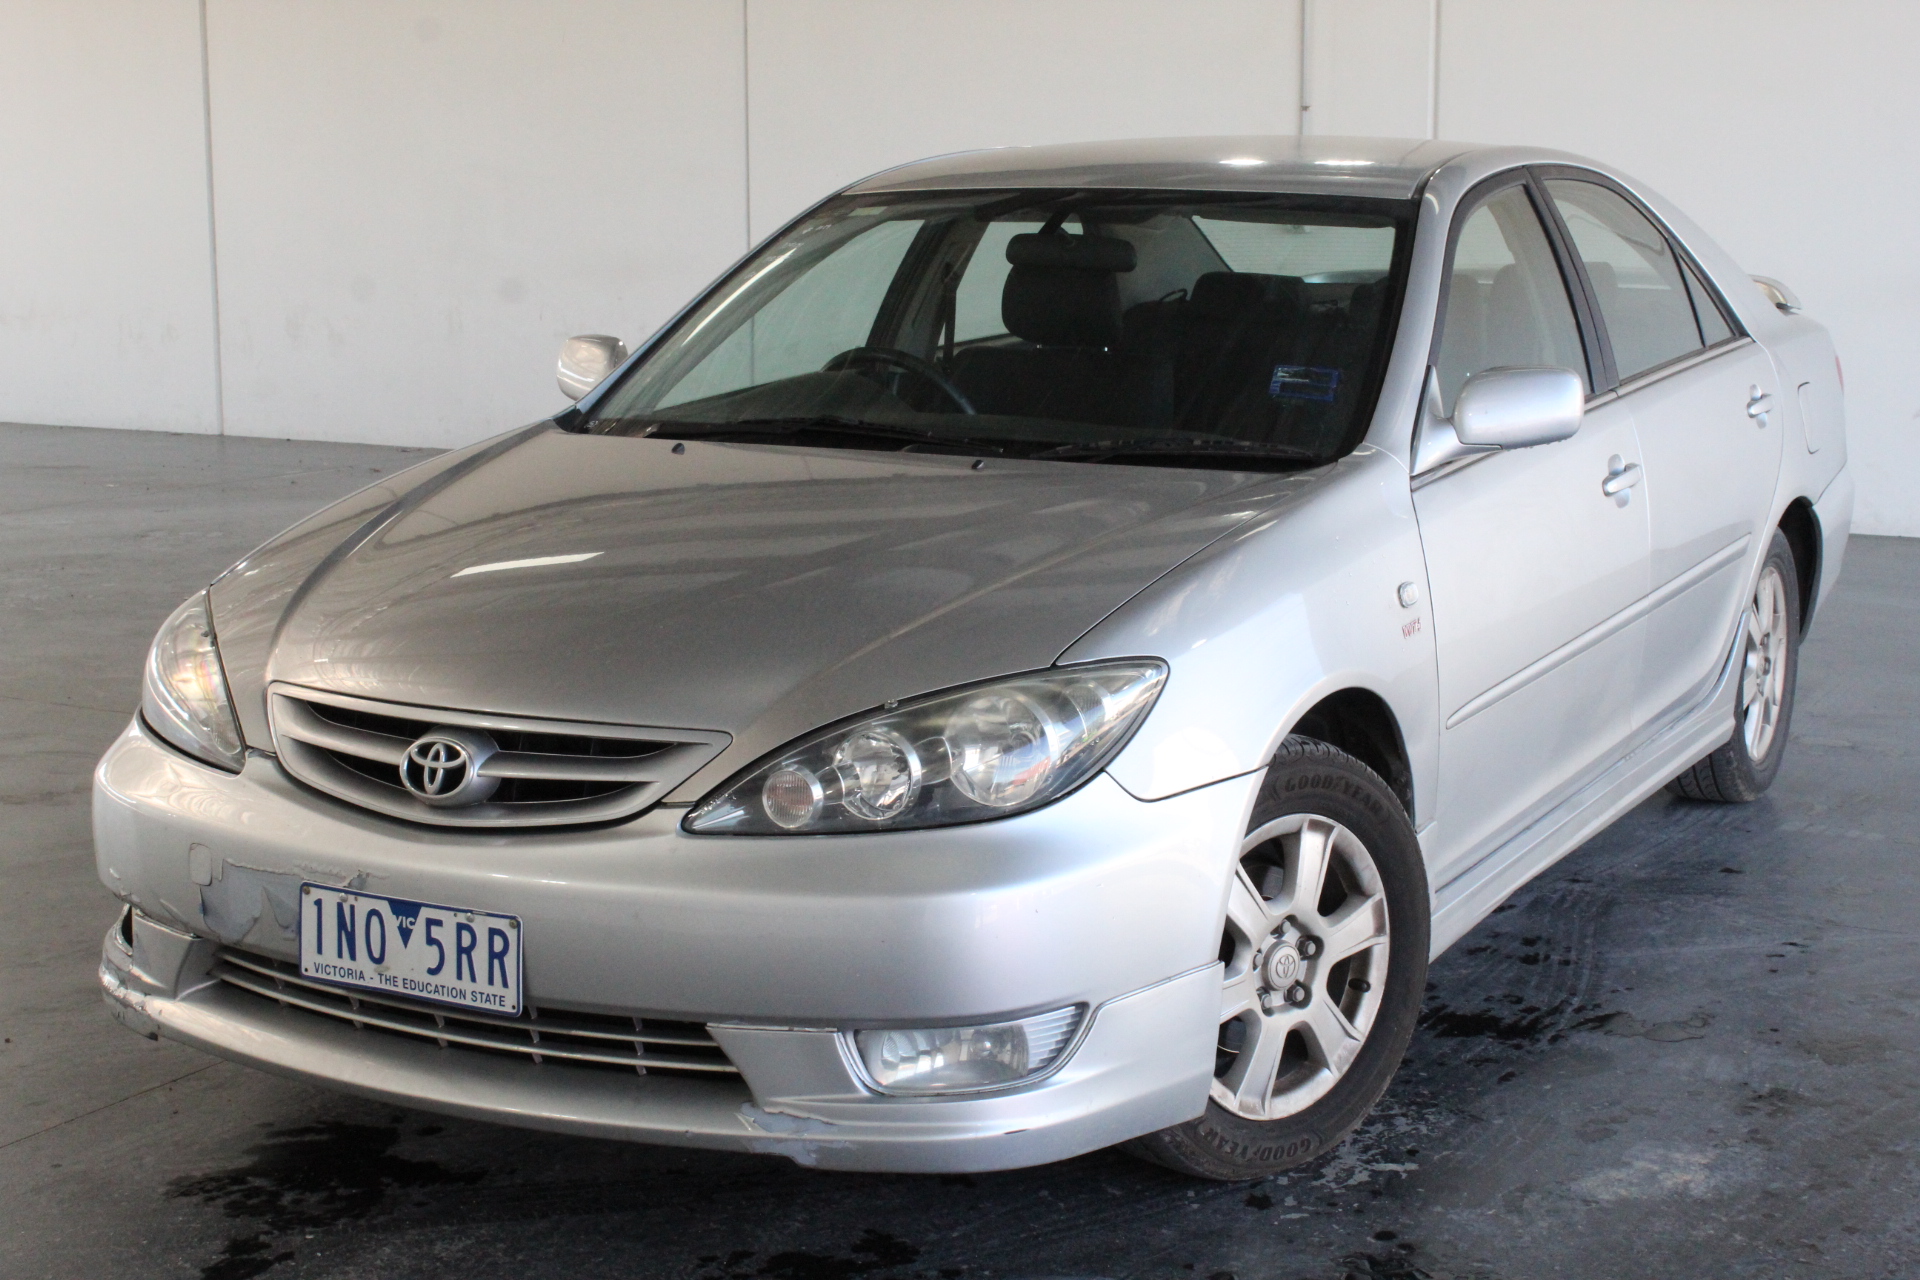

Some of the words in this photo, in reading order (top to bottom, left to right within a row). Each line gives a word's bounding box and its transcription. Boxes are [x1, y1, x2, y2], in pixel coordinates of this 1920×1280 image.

[396, 914, 416, 929] VIC
[425, 917, 510, 989] 5RR
[313, 962, 366, 982] VICTORIA
[378, 973, 399, 988] THE
[402, 979, 467, 1001] EDUCATION
[470, 991, 506, 1008] STATE
